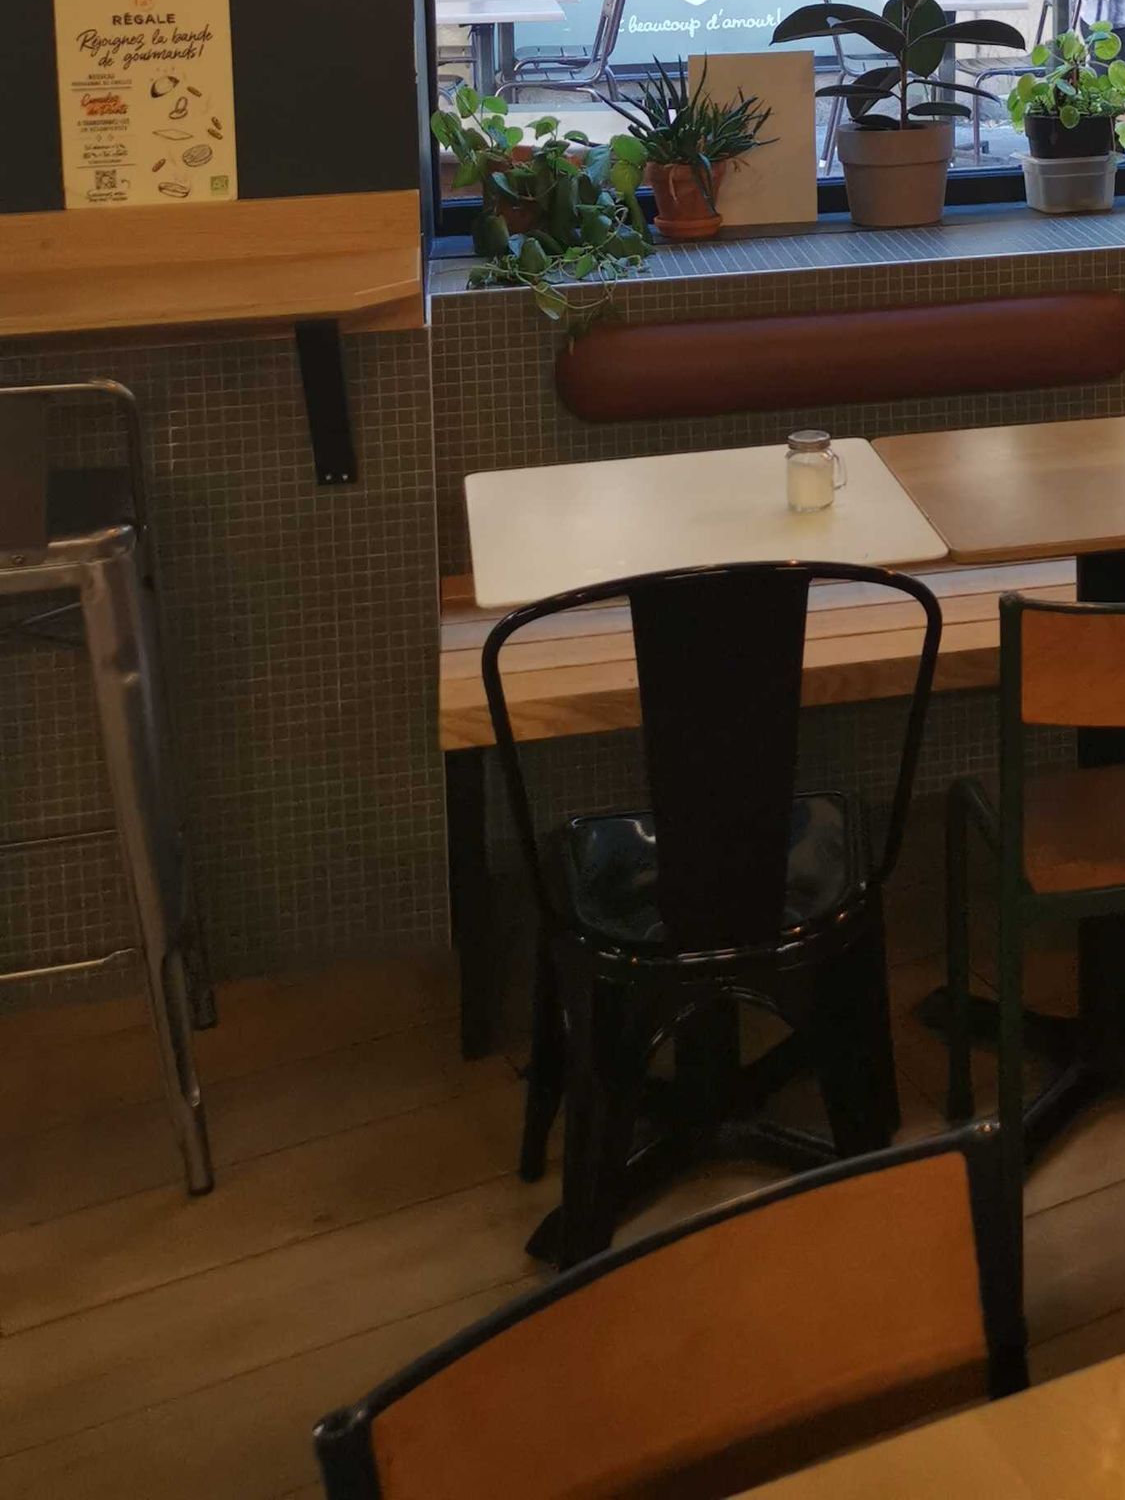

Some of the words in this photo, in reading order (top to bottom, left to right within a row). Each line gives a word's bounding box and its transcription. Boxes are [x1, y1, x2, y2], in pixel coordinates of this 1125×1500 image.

[112, 12, 176, 26] RÉGALE
[628, 15, 701, 38] beaucoup
[152, 28, 167, 45] la
[171, 23, 213, 44] bande
[98, 50, 114, 67] de
